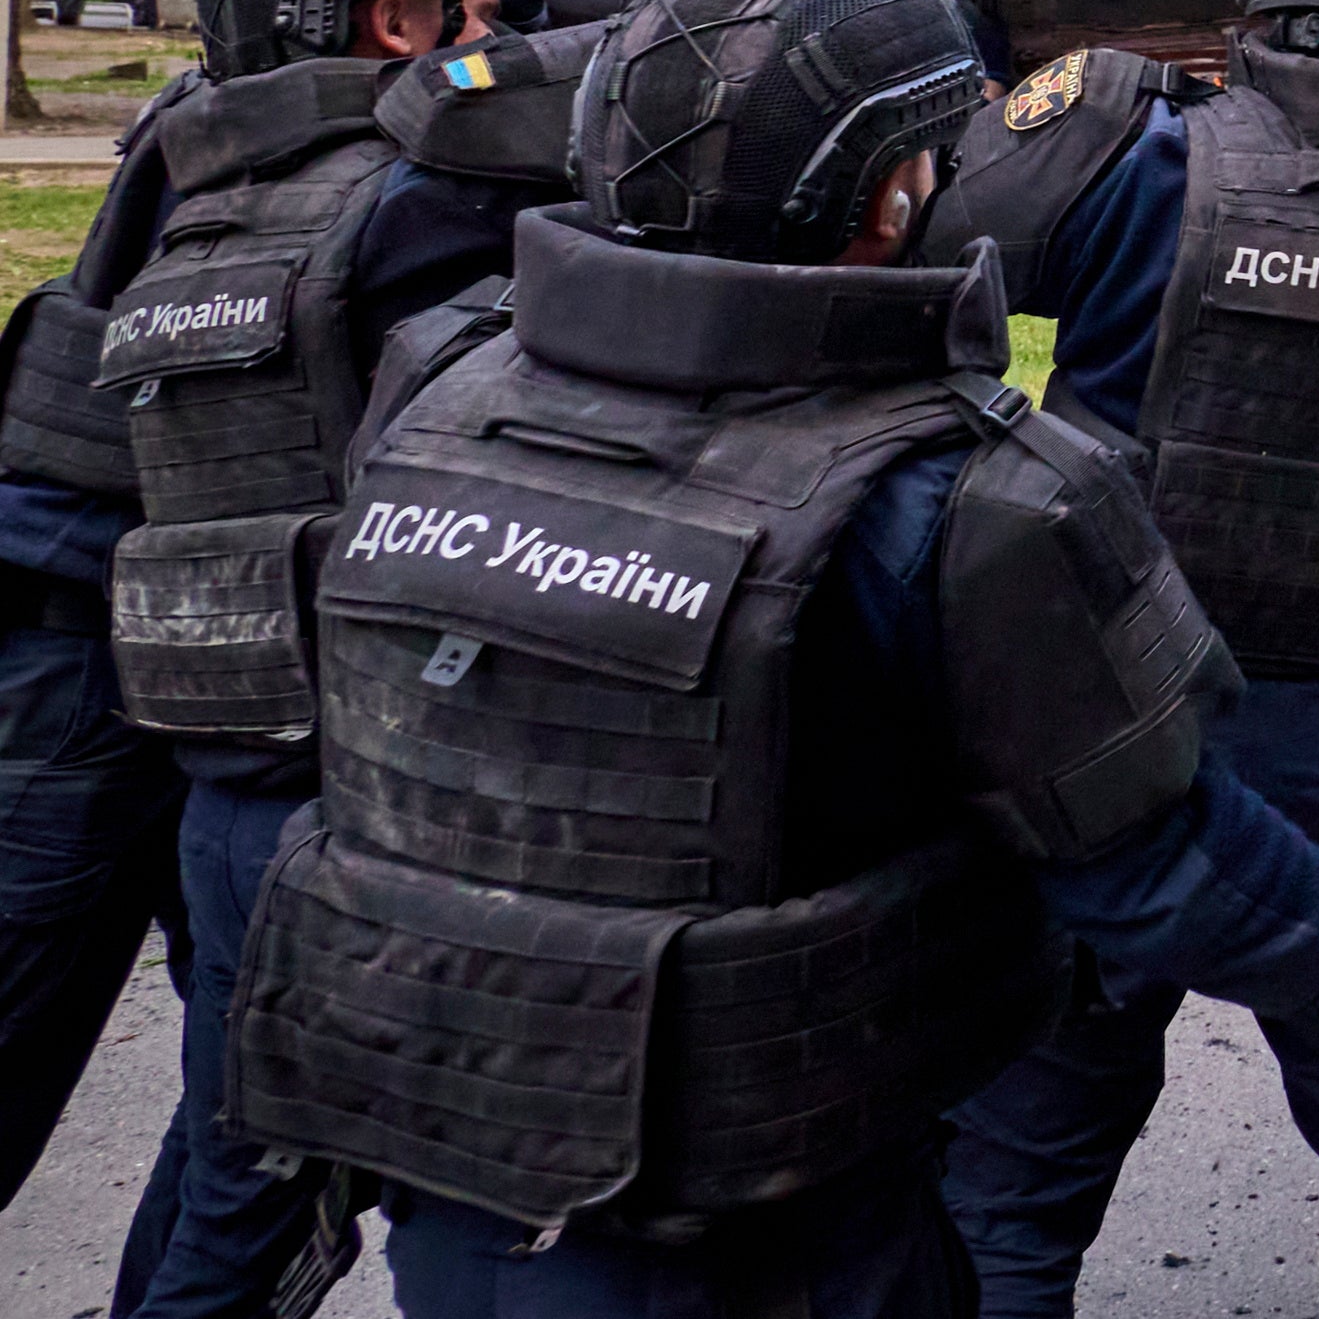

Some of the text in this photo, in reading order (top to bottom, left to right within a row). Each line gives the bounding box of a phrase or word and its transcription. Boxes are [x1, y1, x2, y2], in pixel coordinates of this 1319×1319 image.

[101, 293, 268, 362] ДСНС України
[345, 501, 711, 620] ДСНС України
